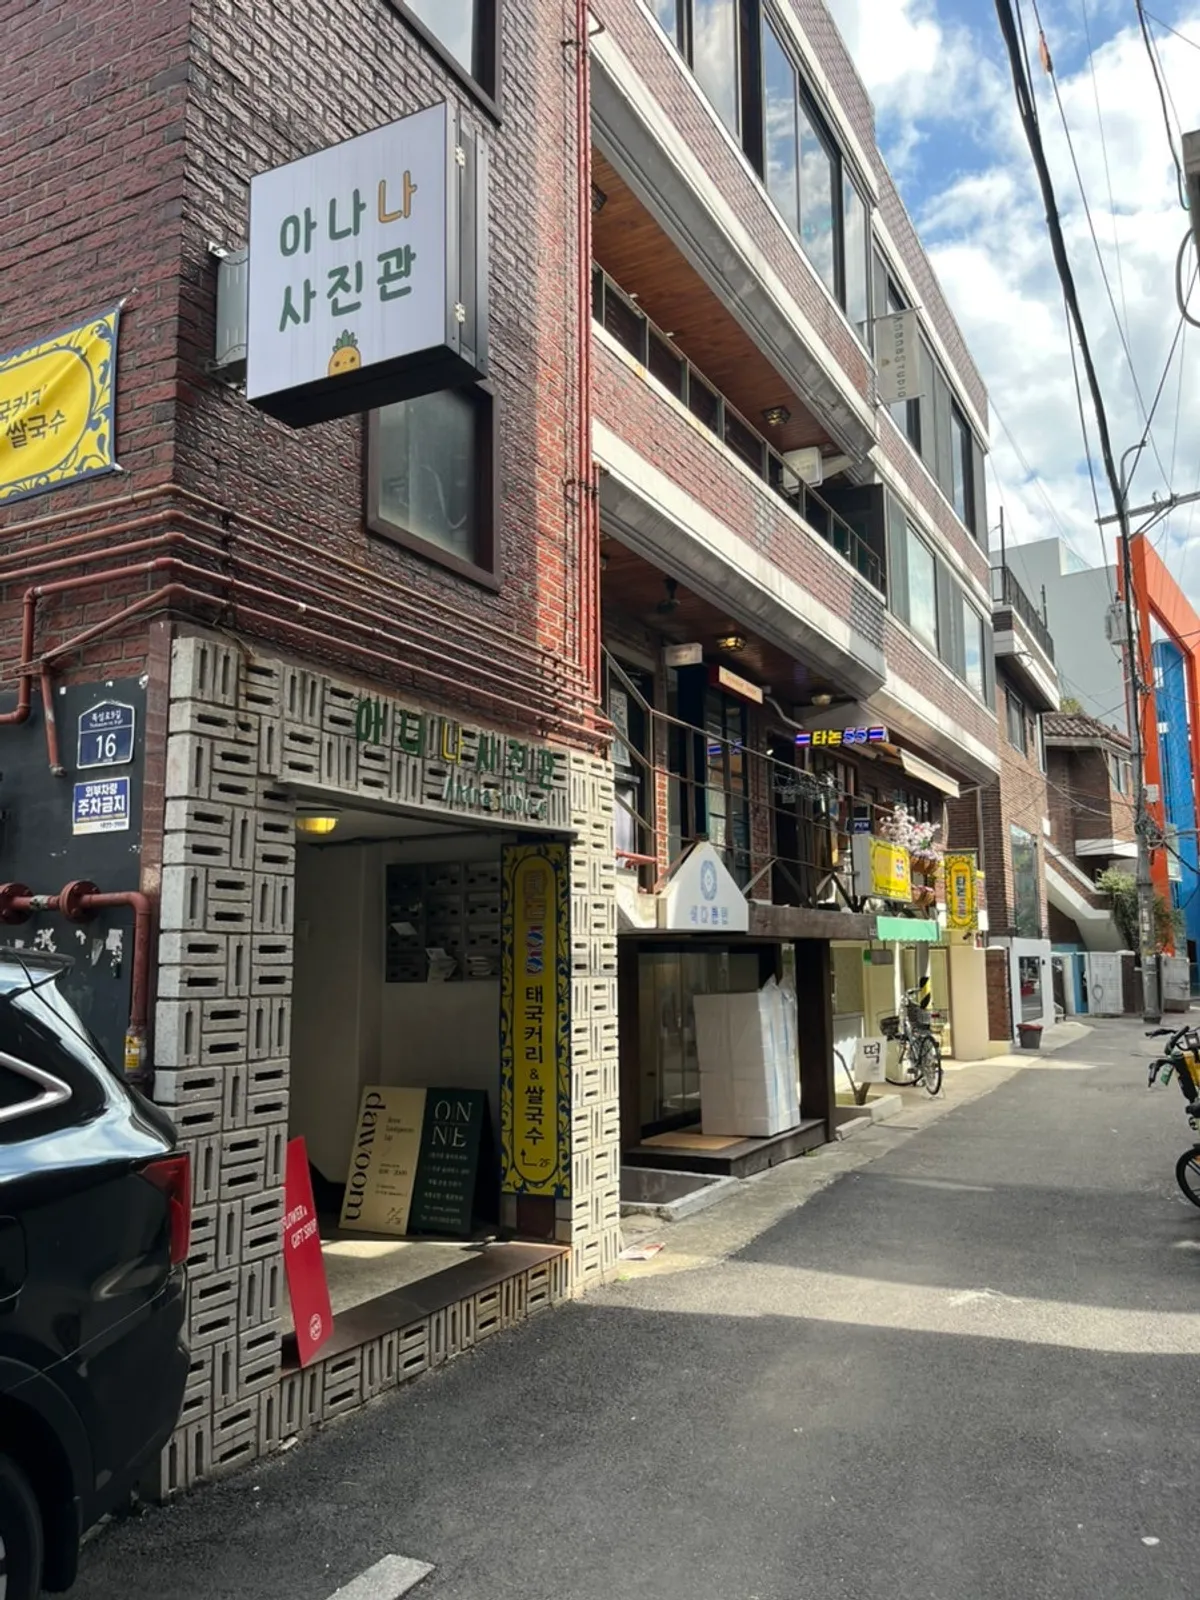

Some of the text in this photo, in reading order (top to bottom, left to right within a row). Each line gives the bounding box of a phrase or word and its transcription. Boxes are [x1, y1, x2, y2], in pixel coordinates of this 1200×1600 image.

[280, 170, 418, 257] 아나나
[278, 244, 417, 333] 사진관
[6, 411, 68, 449] 쌀국수
[96, 733, 116, 759] 16
[78, 795, 125, 815] 주차금지
[85, 783, 118, 797] 외부차량
[524, 985, 545, 1145] 태국커리 & 쌀국수
[863, 1041, 880, 1064] 떡
[345, 1092, 387, 1221] dawoom
